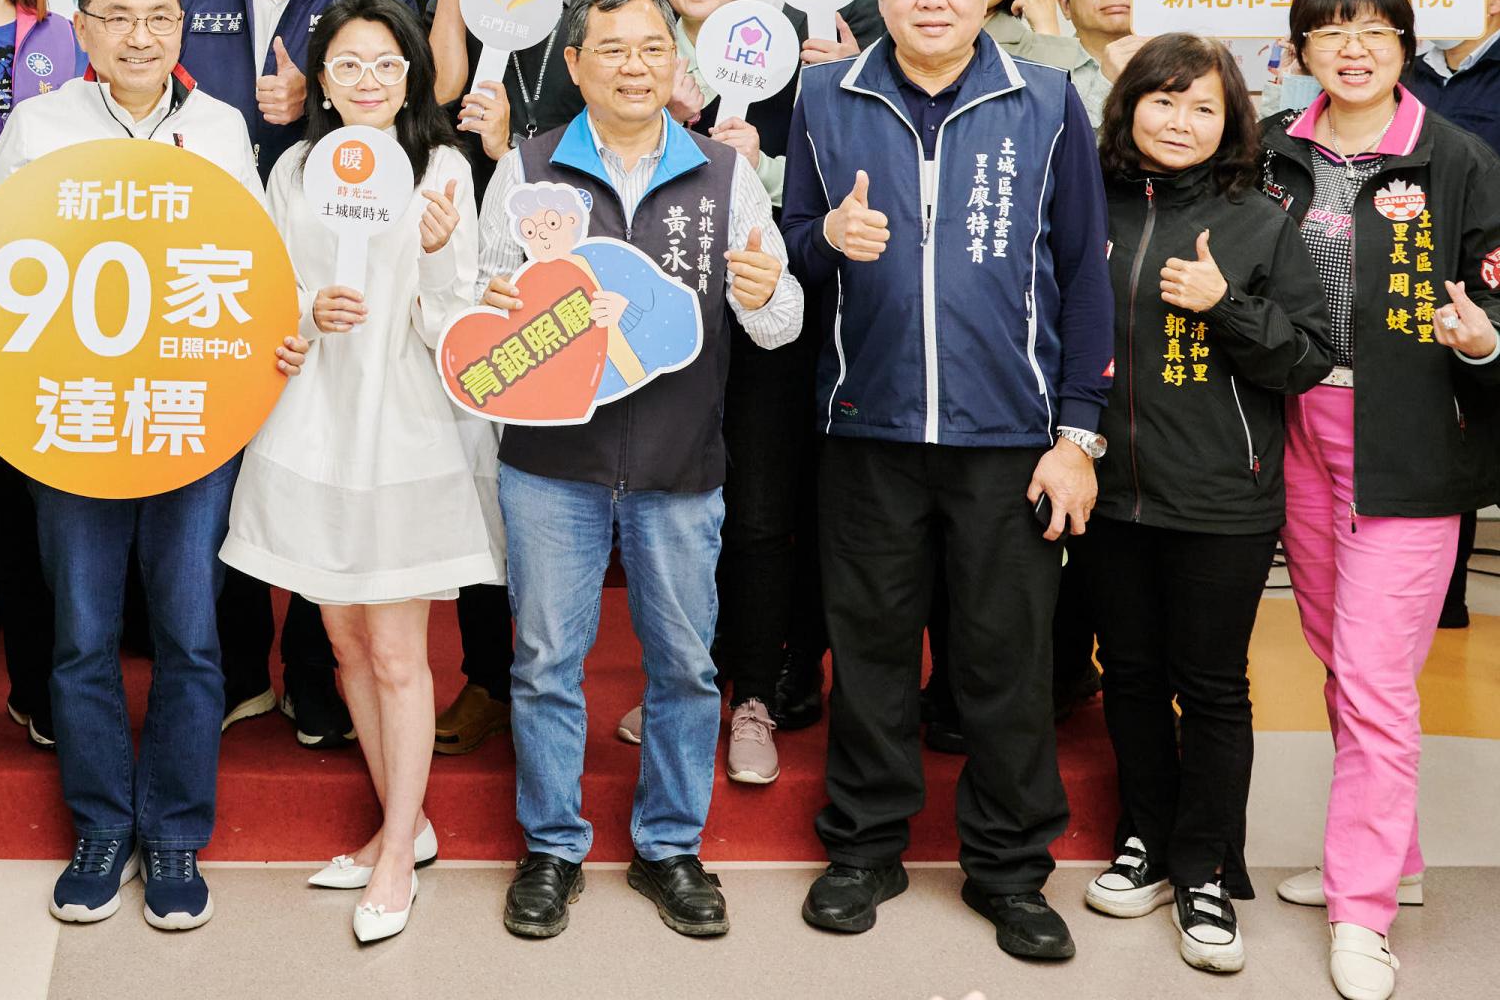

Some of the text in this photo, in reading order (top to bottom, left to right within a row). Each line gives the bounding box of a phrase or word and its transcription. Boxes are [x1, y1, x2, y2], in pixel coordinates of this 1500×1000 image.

[715, 66, 767, 90] 汐止輕安
[340, 147, 363, 170] 暖
[57, 179, 192, 222] 新北市
[322, 202, 389, 221] 土城暖時光
[992, 137, 1017, 258] 土城區青雲里
[1375, 195, 1425, 205] CANADA
[662, 206, 692, 282] 黃永
[697, 196, 716, 294] 新北市議員
[160, 337, 252, 360] 日照中心
[460, 288, 595, 405] 青銀照顧
[1161, 312, 1187, 387] 郭真好
[32, 377, 208, 456] 達標
